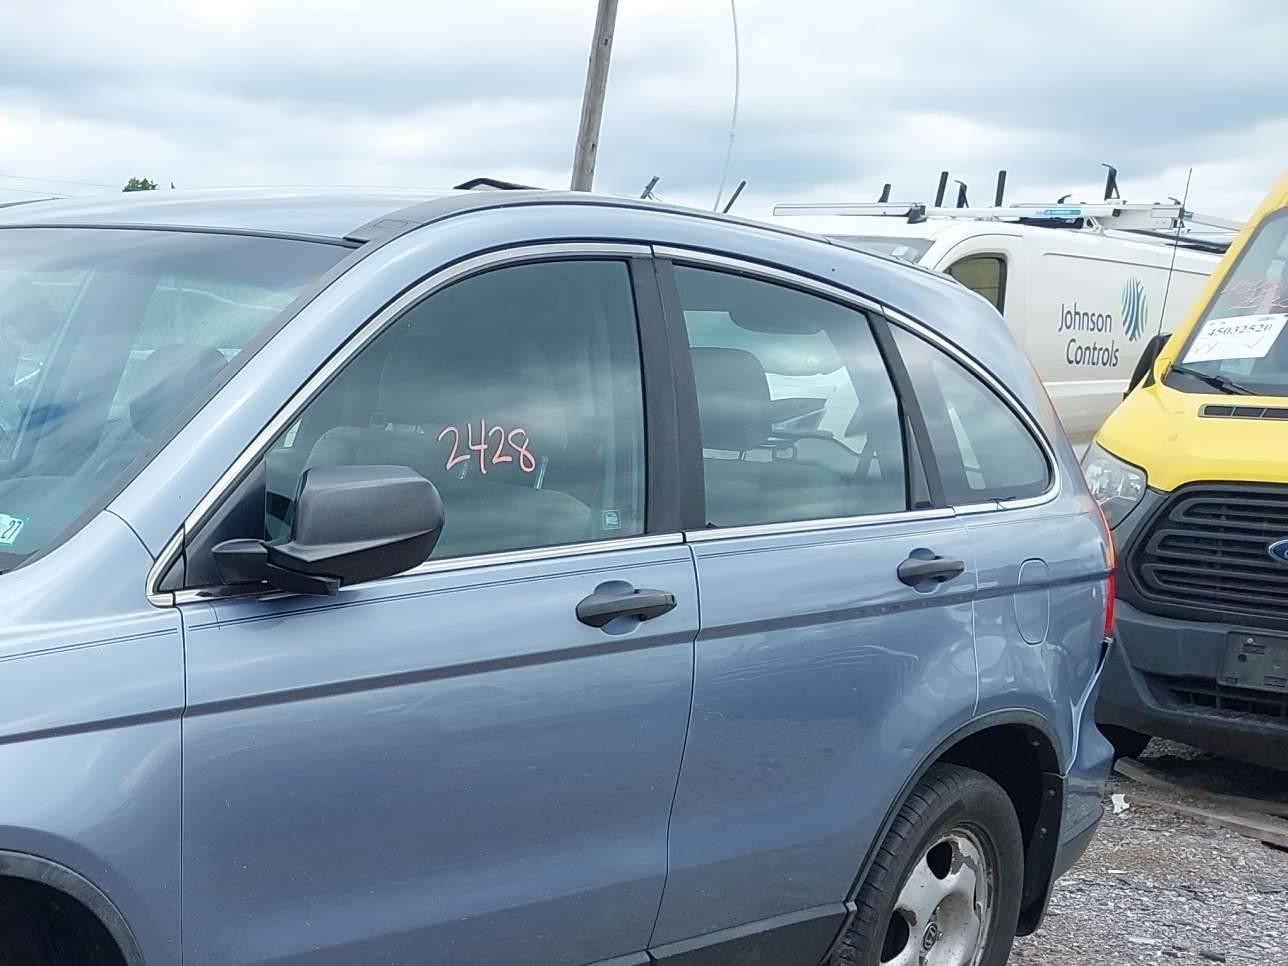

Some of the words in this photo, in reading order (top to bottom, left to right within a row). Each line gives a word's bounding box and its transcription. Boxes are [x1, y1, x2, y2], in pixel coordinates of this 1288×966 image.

[1057, 301, 1113, 333] Johnson
[1065, 337, 1120, 368] Controls
[437, 417, 537, 475] 2428
[0, 519, 23, 540] 27
